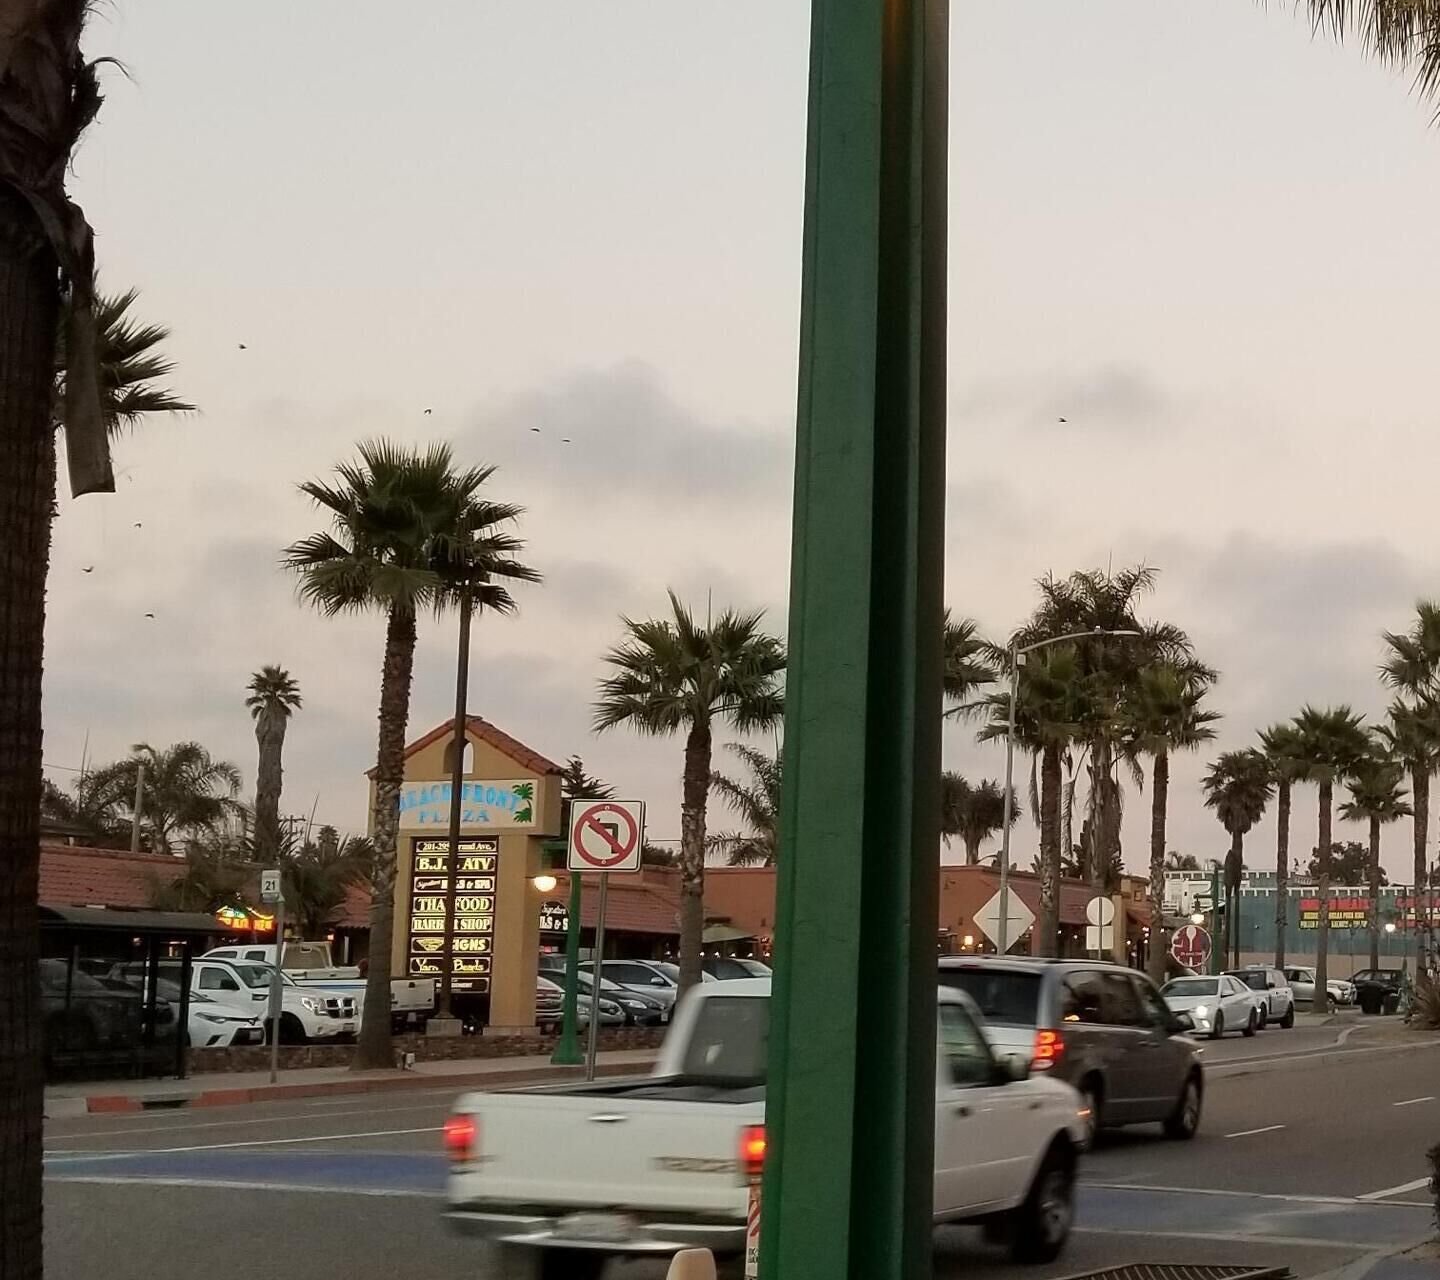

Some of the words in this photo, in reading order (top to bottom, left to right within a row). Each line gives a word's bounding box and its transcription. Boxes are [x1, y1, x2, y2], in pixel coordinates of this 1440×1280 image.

[418, 810, 490, 824] PLZA
[462, 857, 491, 870] ATV
[265, 881, 276, 891] 21
[418, 898, 447, 911] THA
[454, 897, 490, 910] FOOD
[413, 919, 459, 930] BARBR
[460, 918, 490, 930] SHOP
